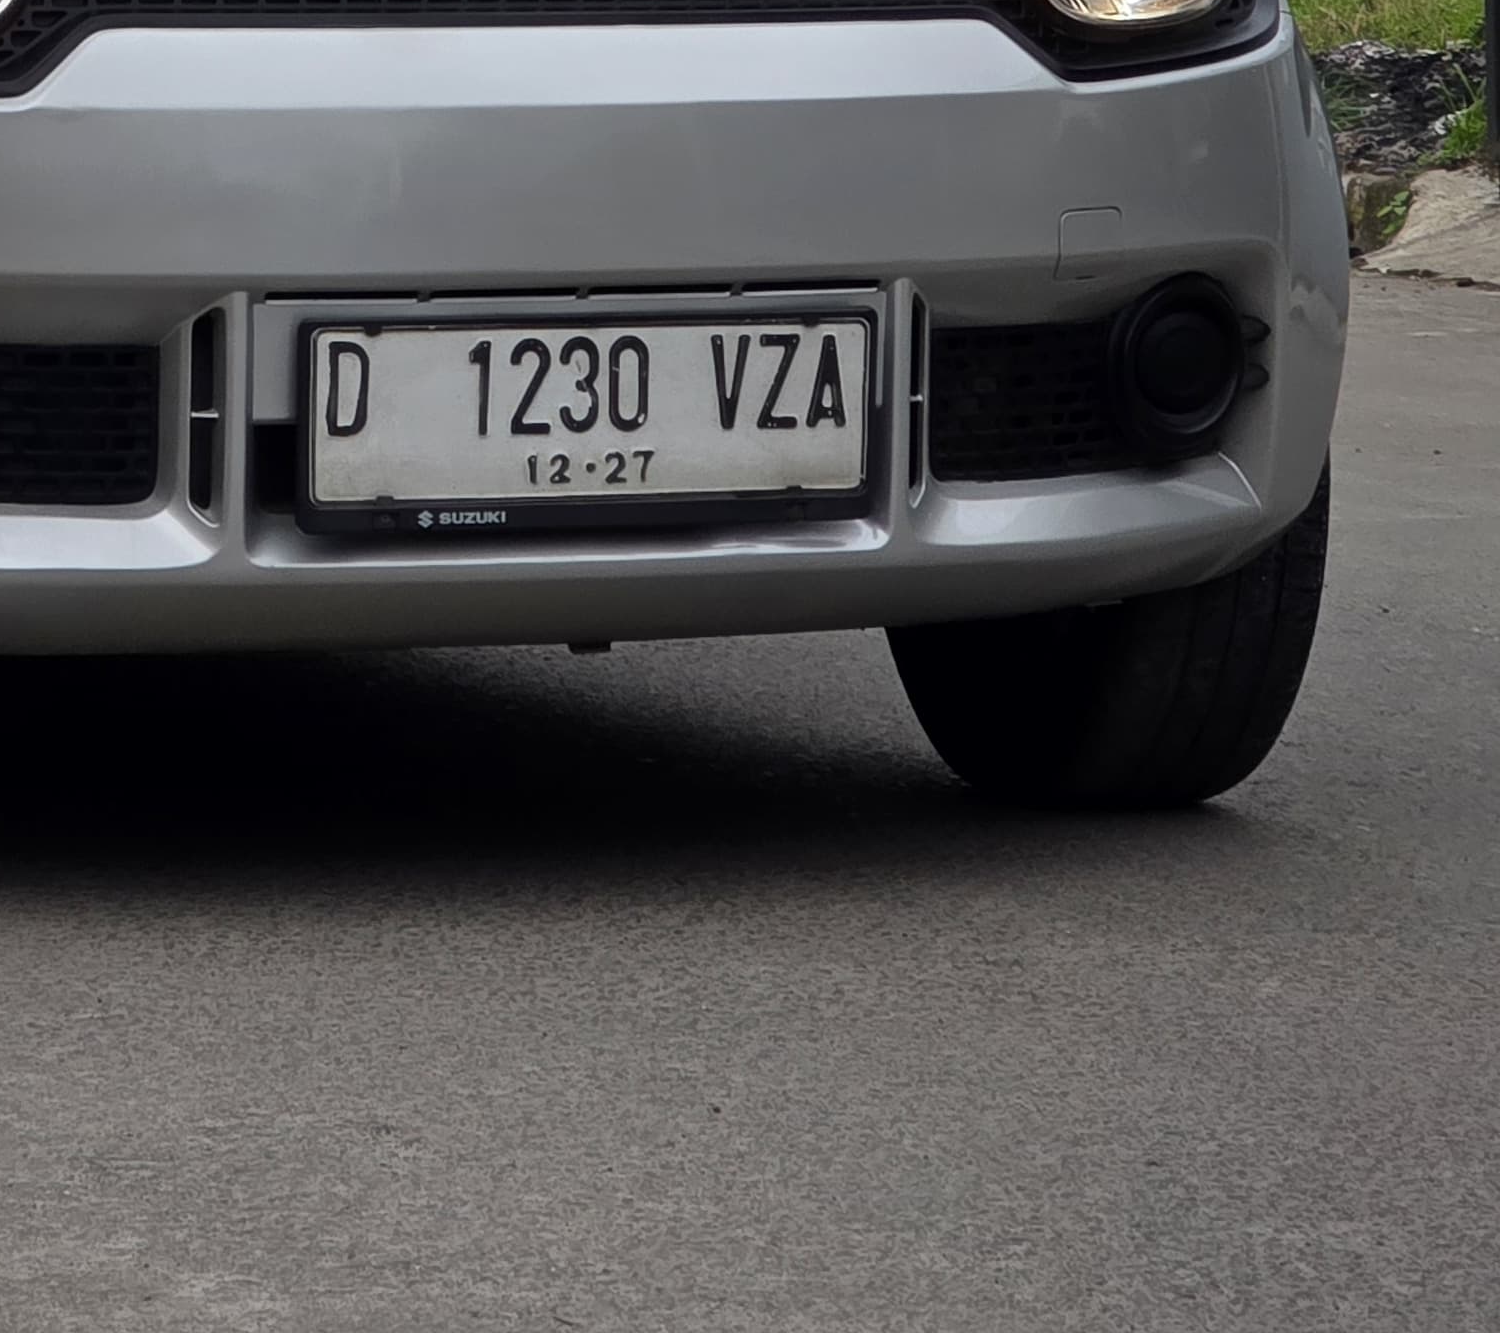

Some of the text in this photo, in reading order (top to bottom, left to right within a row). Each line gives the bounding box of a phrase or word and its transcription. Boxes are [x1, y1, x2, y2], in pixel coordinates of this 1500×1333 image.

[325, 335, 846, 436] D 1230 VZA
[439, 511, 506, 525] SUZUKI
